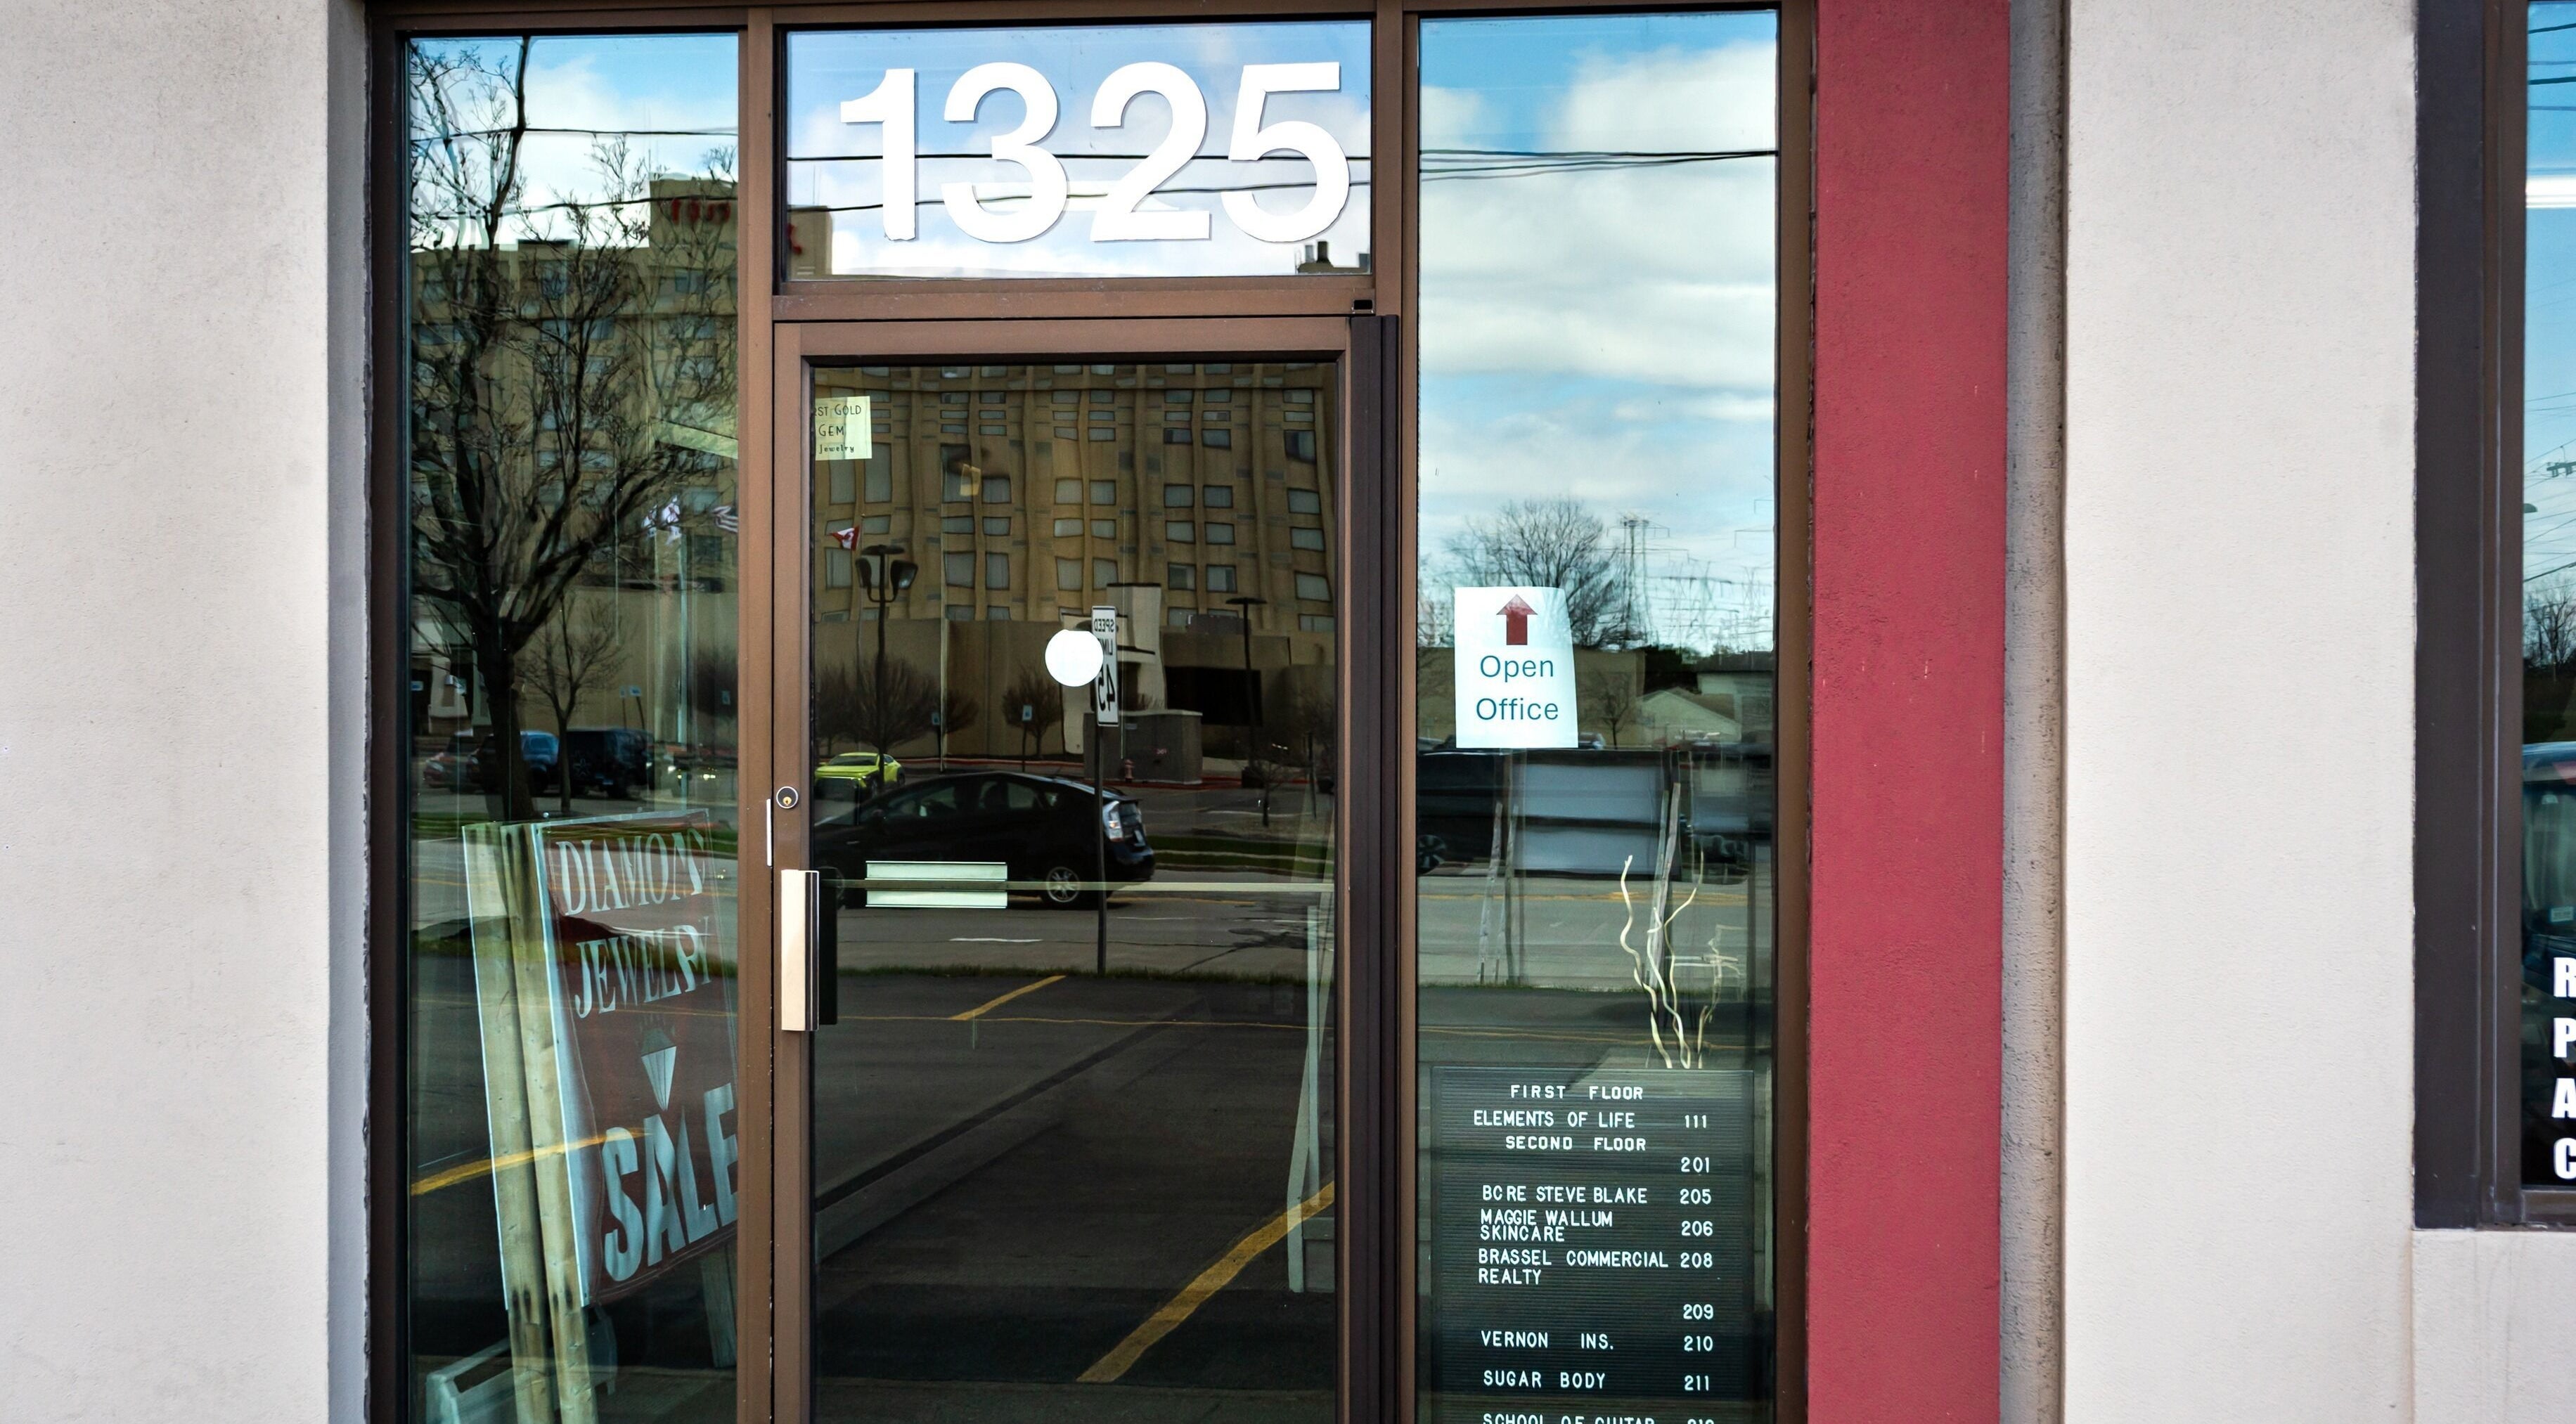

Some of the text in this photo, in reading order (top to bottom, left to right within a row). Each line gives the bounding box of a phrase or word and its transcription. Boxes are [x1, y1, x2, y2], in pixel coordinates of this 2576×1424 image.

[840, 61, 1351, 243] 1325
[834, 403, 862, 415] GOLD
[818, 423, 844, 436] GEM
[1480, 655, 1554, 682] Open
[1476, 697, 1559, 720] Office
[1510, 1084, 1644, 1101] FIRST FLOOR
[1474, 1109, 1707, 1129] ELEMENTS OF LIFE 111
[1505, 1135, 1647, 1152] SECOND FLOOR
[1680, 1156, 1711, 1173] 201
[602, 1082, 738, 1282] SALE
[1535, 1185, 1587, 1203] STEVE
[1592, 1186, 1648, 1204] BLAKE
[1680, 1188, 1712, 1205] 205
[1480, 1208, 1613, 1227] MAGGIE WALLUM
[1480, 1225, 1565, 1242] SKINCARE
[1681, 1220, 1713, 1237] 206
[1479, 1248, 1713, 1269] BRASSEL COMMERCIAL 208
[1479, 1267, 1542, 1285] REALTY
[1683, 1303, 1714, 1320] 209
[1481, 1330, 1713, 1352] VERNON INS. 210
[1483, 1370, 1710, 1391] SUGAR BODY 211
